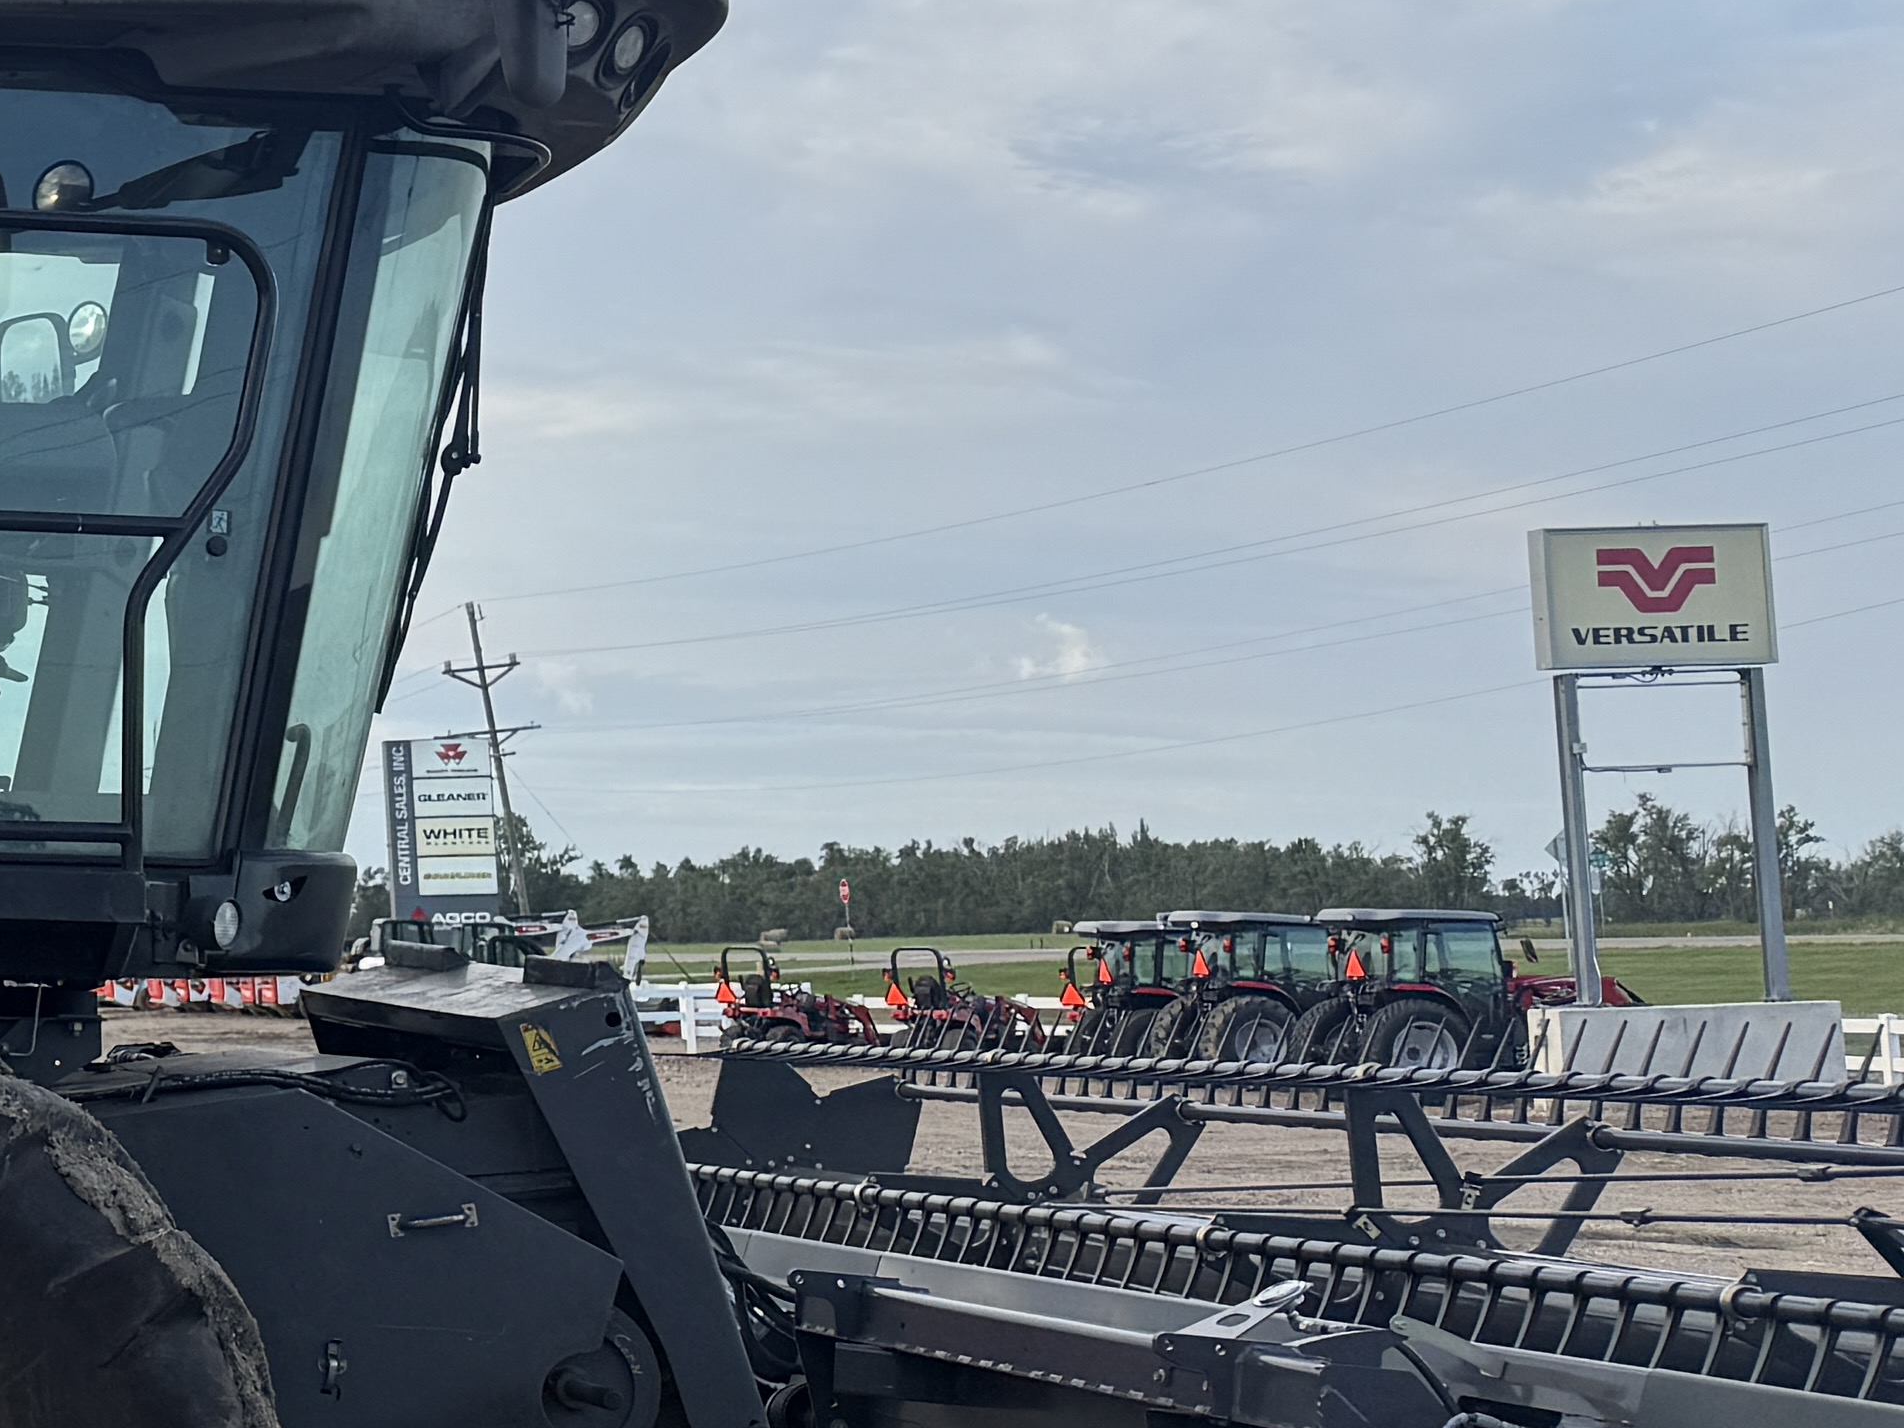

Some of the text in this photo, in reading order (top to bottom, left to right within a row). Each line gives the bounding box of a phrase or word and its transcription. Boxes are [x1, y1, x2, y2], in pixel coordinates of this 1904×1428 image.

[1571, 623, 1750, 646] VERSATILE
[418, 792, 487, 802] GLEANER
[422, 827, 489, 840] WHITE
[396, 821, 411, 885] CENTRAL
[431, 912, 491, 924] AGCO
